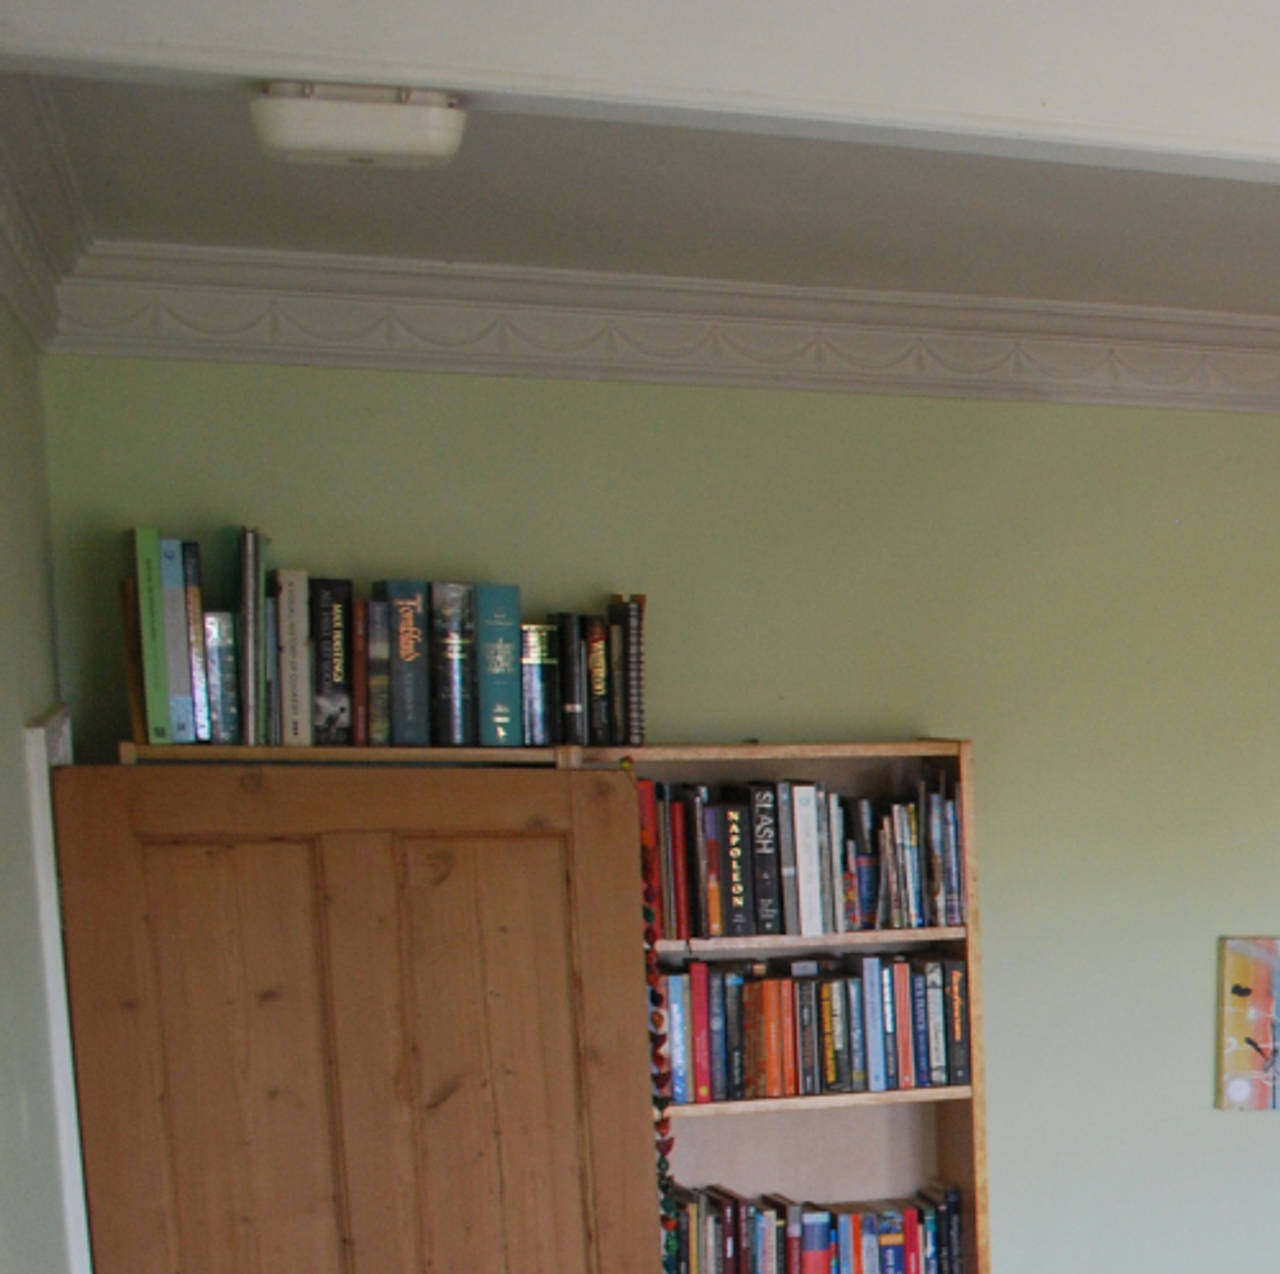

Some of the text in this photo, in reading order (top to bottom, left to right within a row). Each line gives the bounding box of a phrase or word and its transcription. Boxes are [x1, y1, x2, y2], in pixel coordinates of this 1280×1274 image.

[332, 629, 344, 683] HASTINGS
[755, 791, 775, 855] SLASH
[727, 810, 744, 907] NAPOLEON
